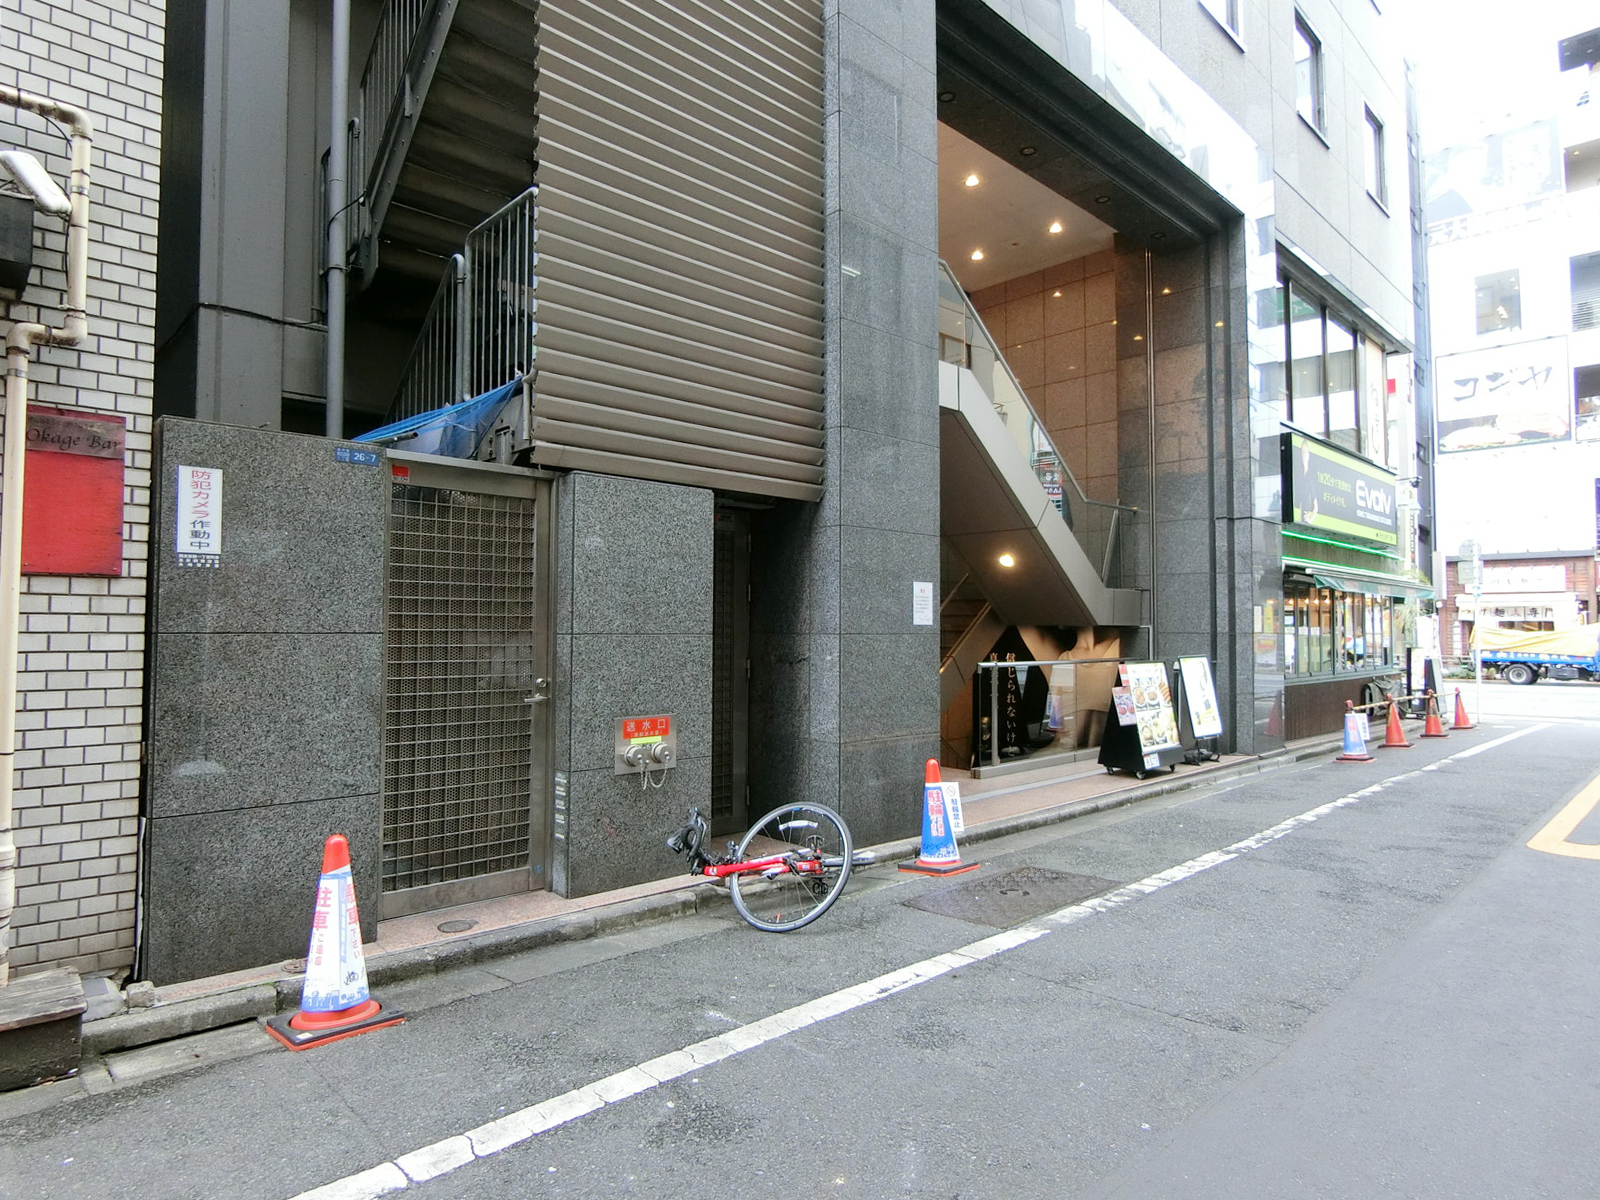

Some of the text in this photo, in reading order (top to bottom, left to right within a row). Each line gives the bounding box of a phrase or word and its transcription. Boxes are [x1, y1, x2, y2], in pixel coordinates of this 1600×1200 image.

[27, 427, 121, 451] Okage Bar
[354, 452, 376, 463] 26-7
[190, 469, 212, 550] 防犯カメラ作動中
[626, 718, 666, 732] 送水口
